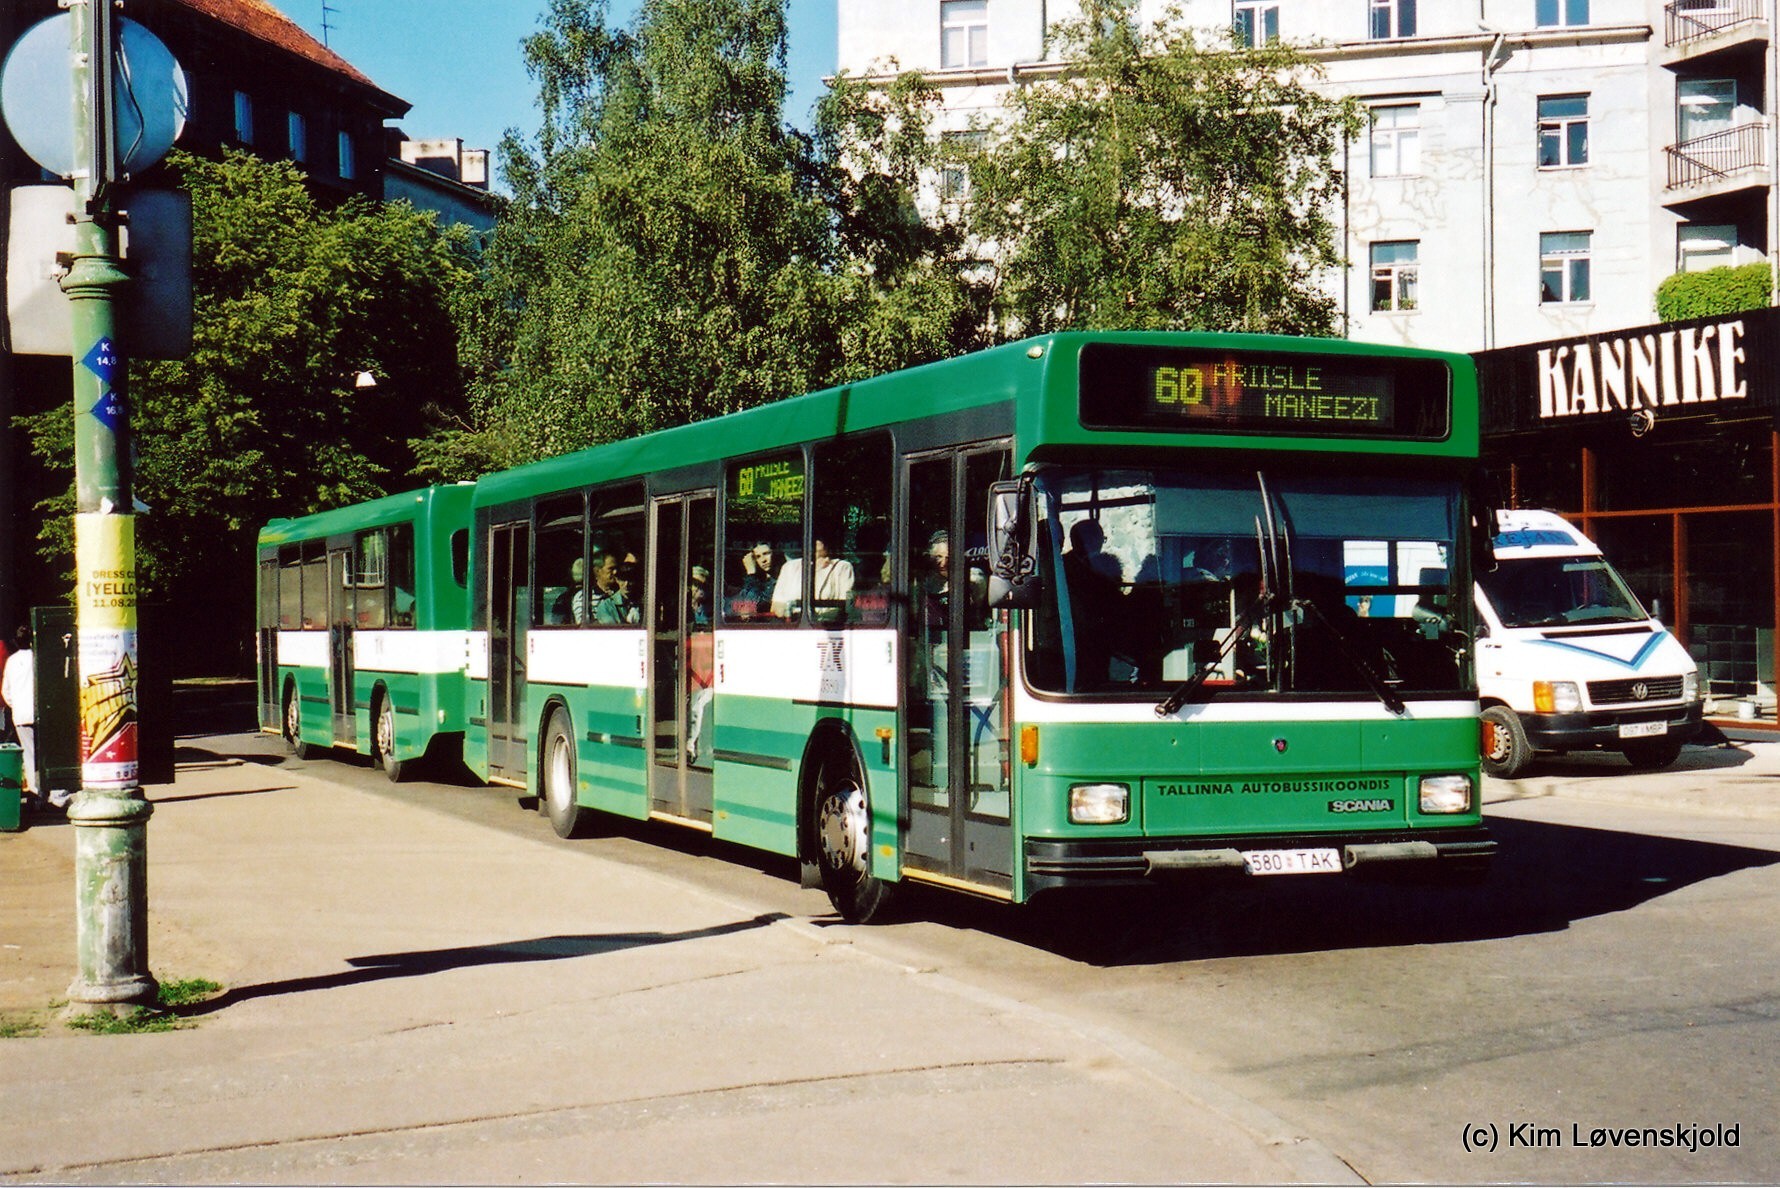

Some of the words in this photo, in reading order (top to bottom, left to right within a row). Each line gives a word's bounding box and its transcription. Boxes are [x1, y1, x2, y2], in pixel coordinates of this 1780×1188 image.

[101, 343, 110, 352] K
[96, 356, 117, 366] 14.8
[1537, 320, 1747, 418] KANNIKE
[1155, 367, 1203, 404] 60
[1213, 363, 1322, 390] PRIISLE
[1265, 394, 1379, 421] MANEEZI
[739, 467, 754, 497] 60
[92, 570, 125, 579] DRESS
[1158, 784, 1234, 796] TALLINNA
[1241, 779, 1390, 794] AUTOBUSSIKOONDIS
[1331, 800, 1391, 813] SCANIA
[1252, 854, 1283, 872] 580
[1296, 852, 1333, 870] TAK
